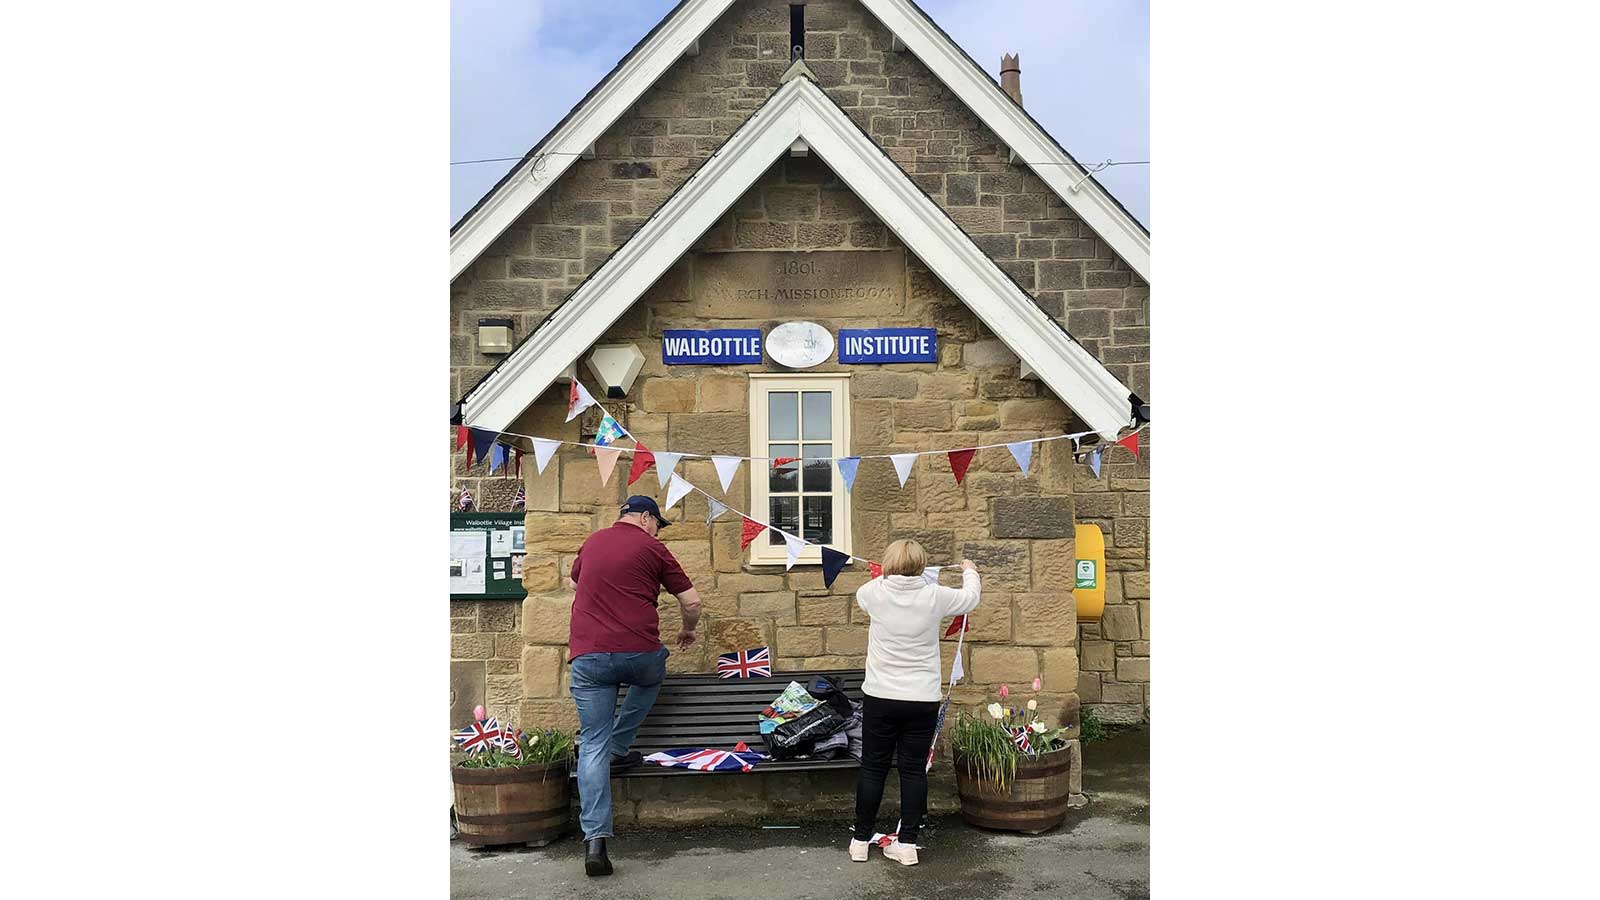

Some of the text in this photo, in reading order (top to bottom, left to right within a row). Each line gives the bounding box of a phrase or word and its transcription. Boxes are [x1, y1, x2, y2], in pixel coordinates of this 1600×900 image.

[775, 288, 841, 300] MISSION
[665, 337, 760, 357] WALBOTTLE
[845, 335, 929, 355] INSTITUTE
